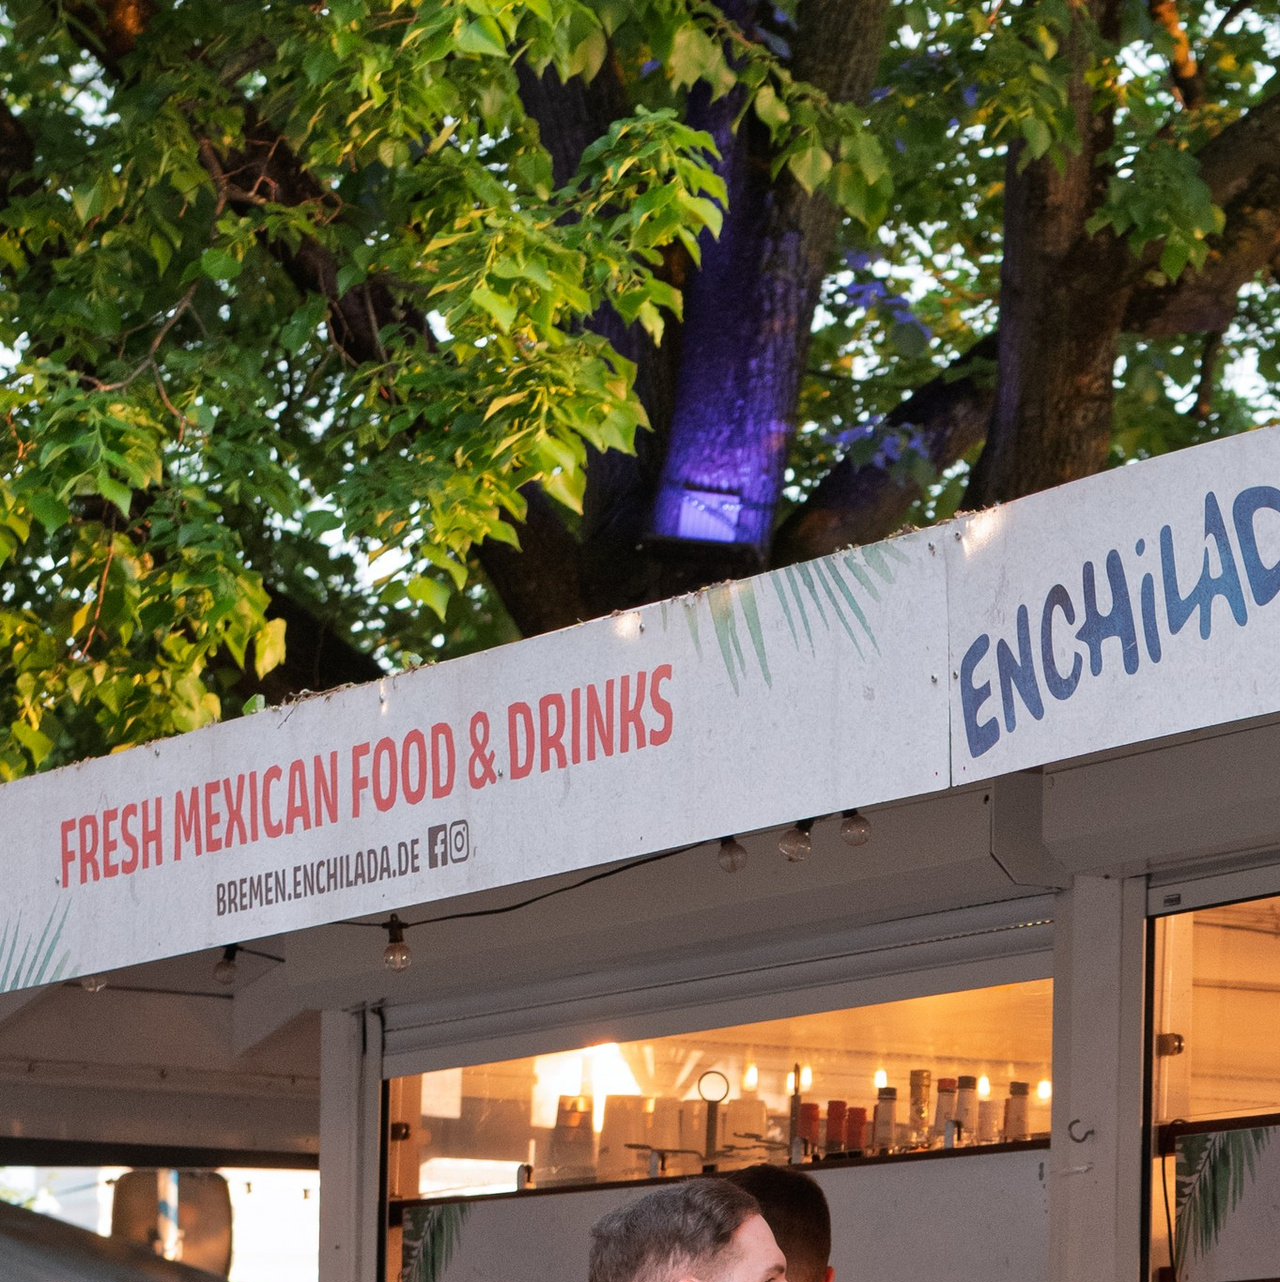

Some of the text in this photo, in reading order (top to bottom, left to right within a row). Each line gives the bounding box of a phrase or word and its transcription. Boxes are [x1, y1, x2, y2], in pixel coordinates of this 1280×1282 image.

[60, 663, 674, 888] FRESH MEXICAN FOOD & DRINKS
[216, 838, 420, 917] BREMEN.ENCHILADA.DE
